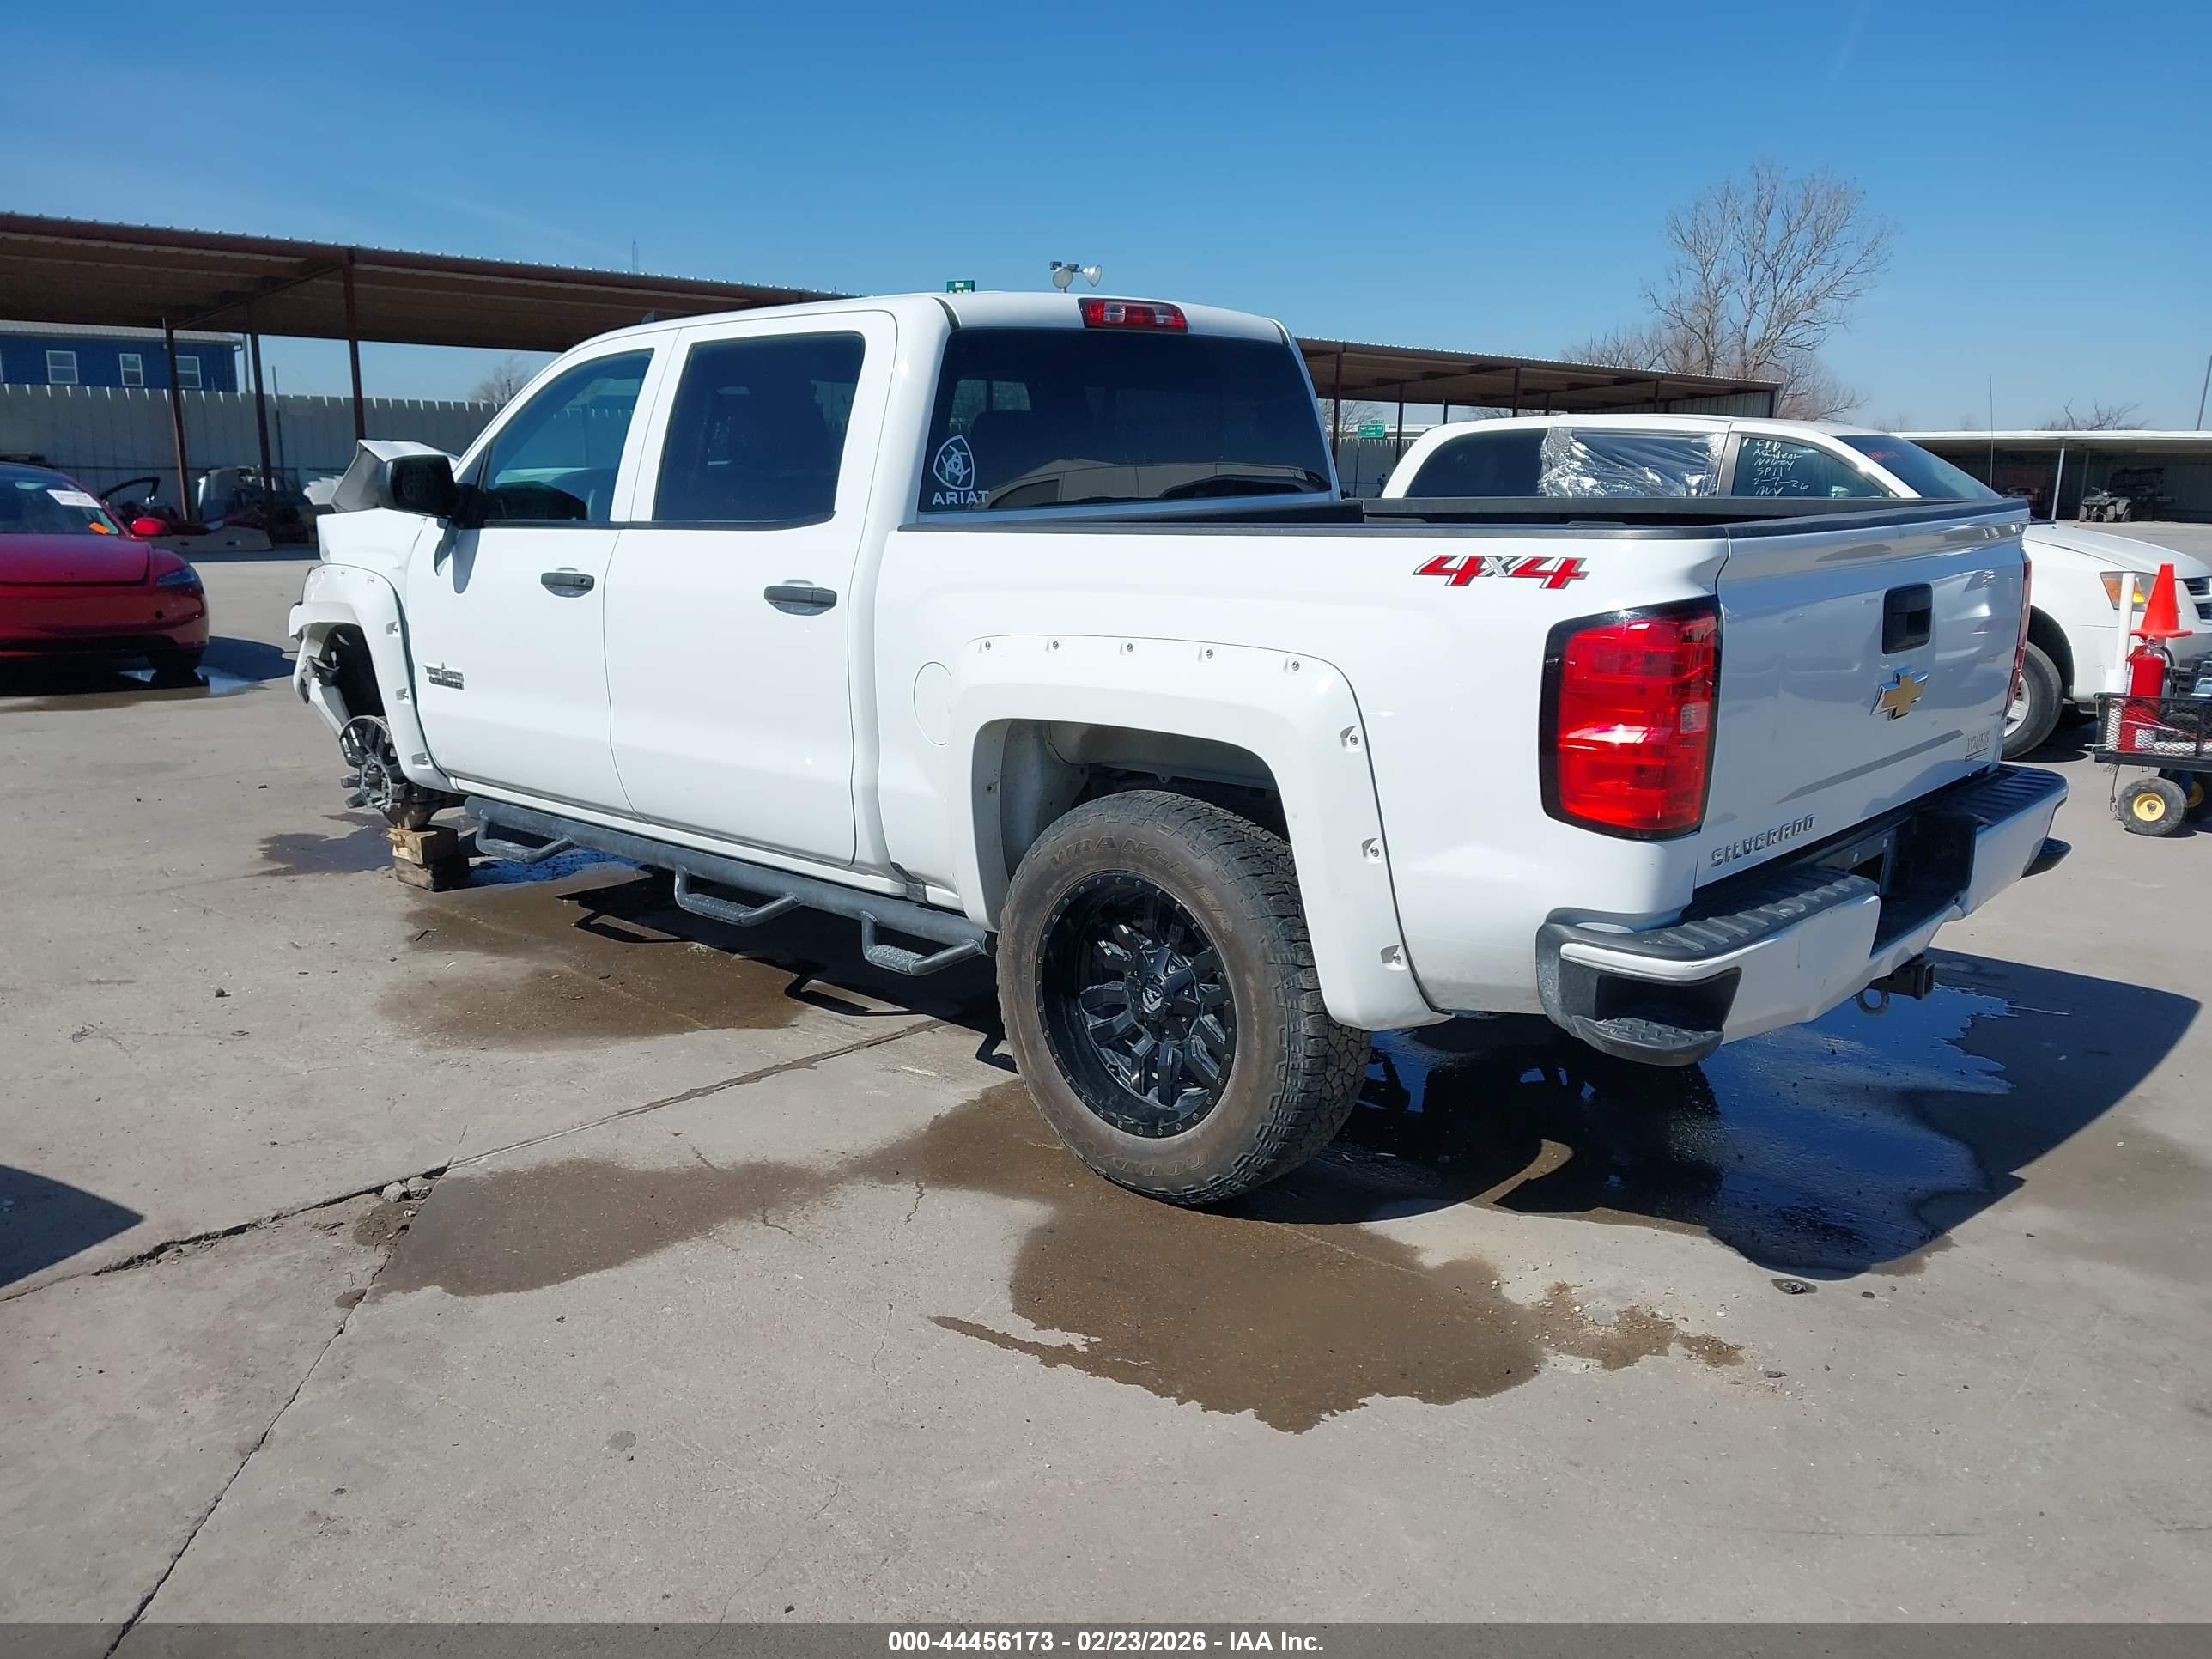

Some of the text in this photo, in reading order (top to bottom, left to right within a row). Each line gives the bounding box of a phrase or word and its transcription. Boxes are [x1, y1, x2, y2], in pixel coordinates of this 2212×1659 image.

[932, 490, 989, 505] ARIAT
[1711, 813, 1815, 867] SILVERADO
[1049, 836, 1243, 938] WRANGLER
